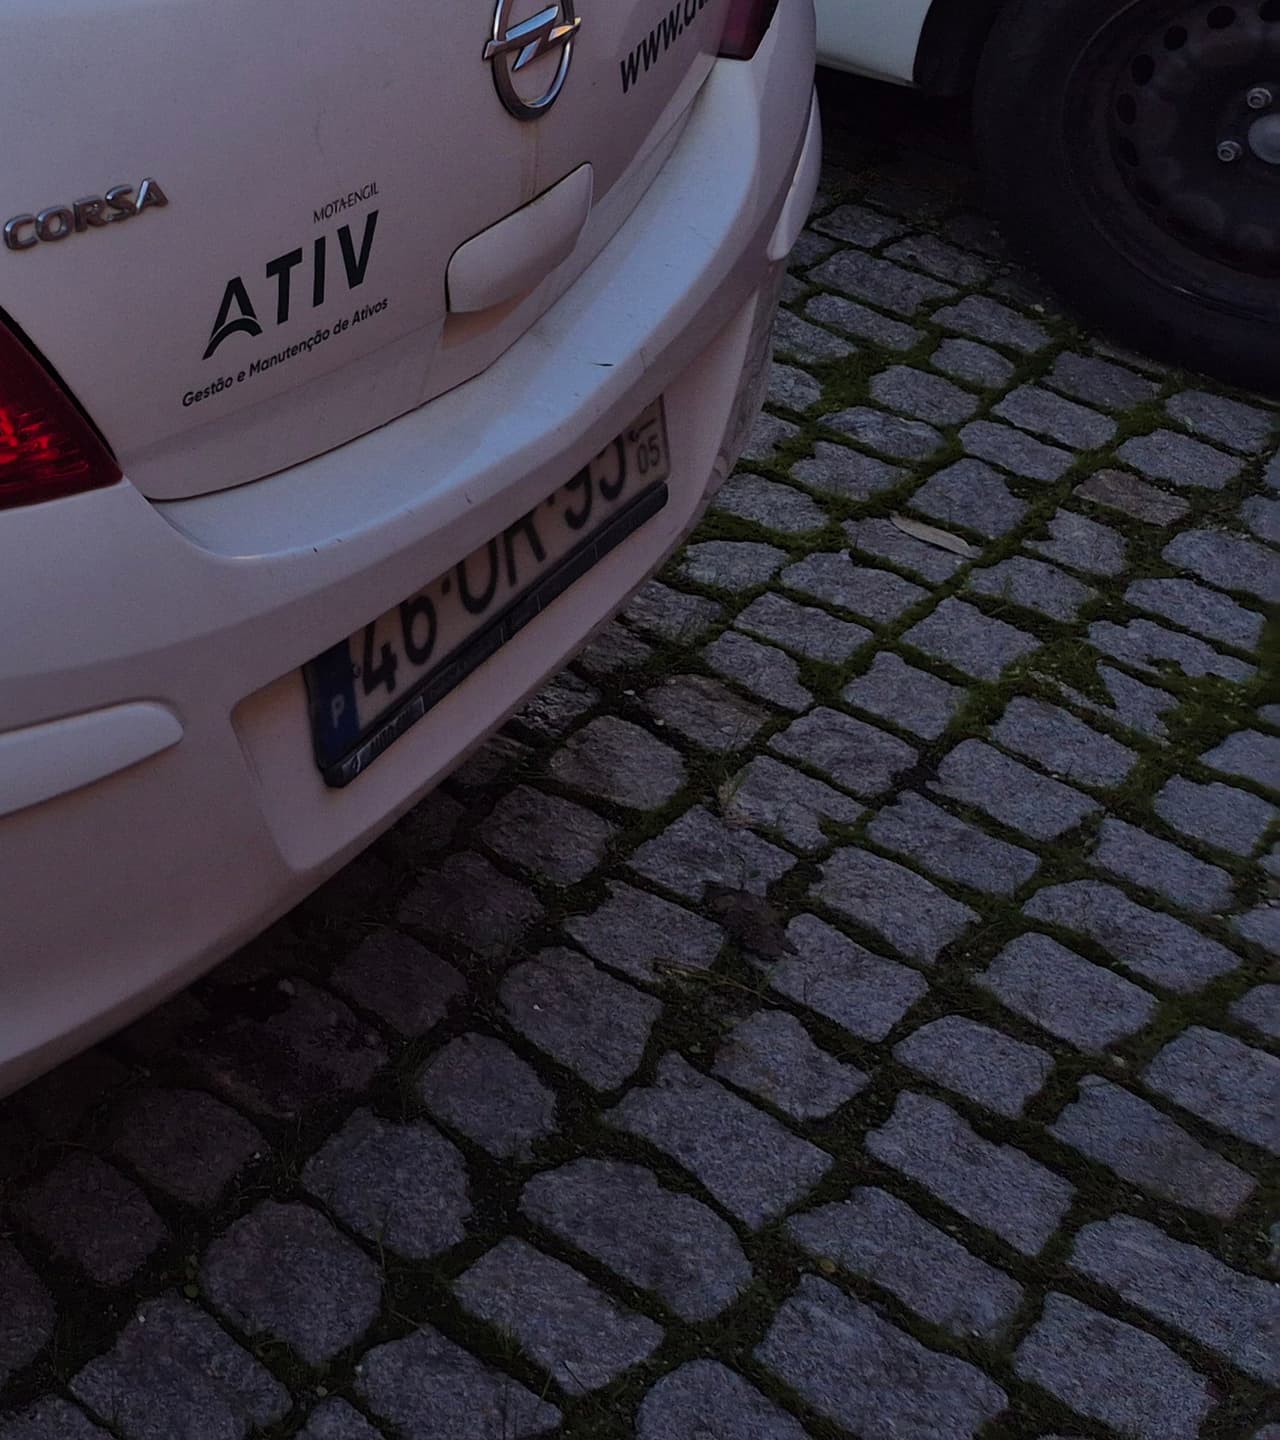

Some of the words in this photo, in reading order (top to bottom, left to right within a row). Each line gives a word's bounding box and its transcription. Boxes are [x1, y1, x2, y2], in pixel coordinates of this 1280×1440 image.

[2, 176, 169, 251] CORSA
[202, 209, 379, 361] ATIV
[182, 377, 233, 407] Gestão
[237, 370, 246, 383] e
[249, 328, 330, 377] Manutenção
[333, 319, 349, 336] de
[352, 298, 389, 327] Ativos
[637, 433, 660, 474] 05
[331, 693, 345, 729] P
